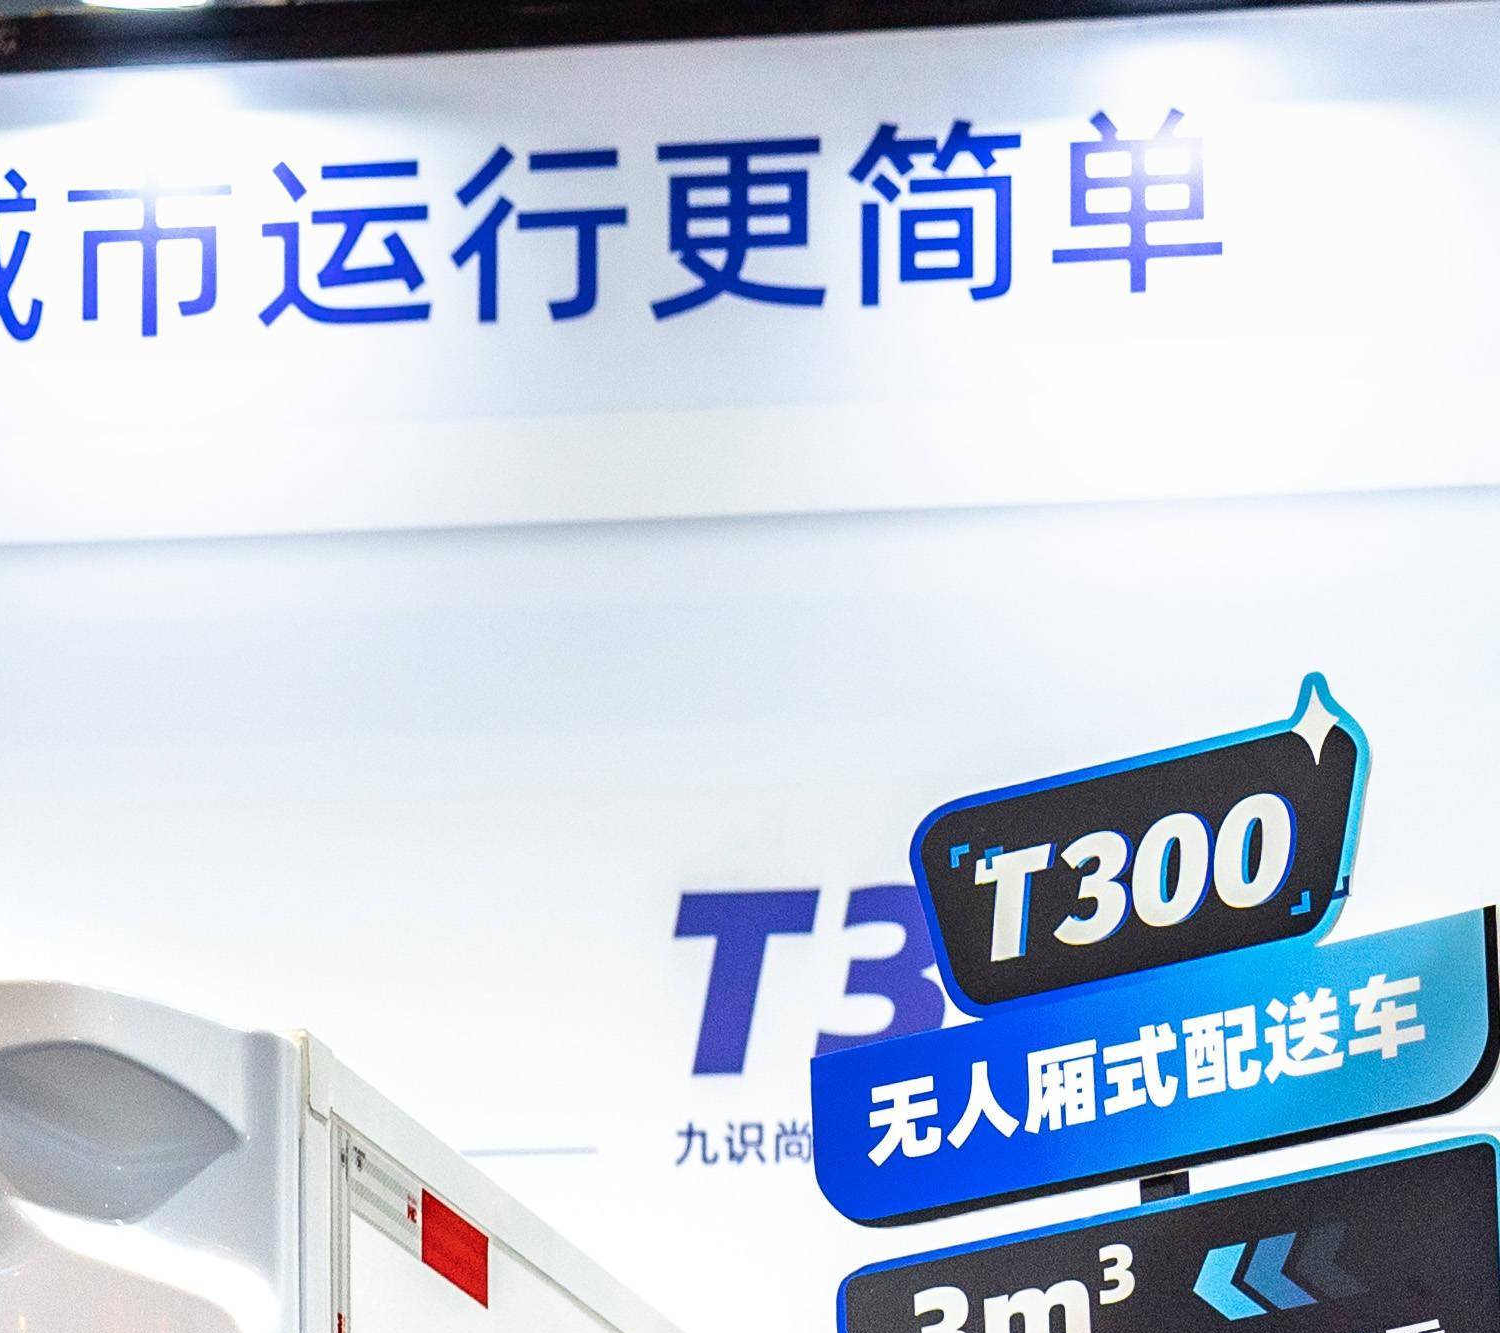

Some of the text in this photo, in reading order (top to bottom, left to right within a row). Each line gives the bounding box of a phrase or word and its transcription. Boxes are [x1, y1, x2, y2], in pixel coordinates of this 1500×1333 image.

[974, 792, 1300, 962] T300
[867, 974, 1427, 1167] 无人厢式配送车
